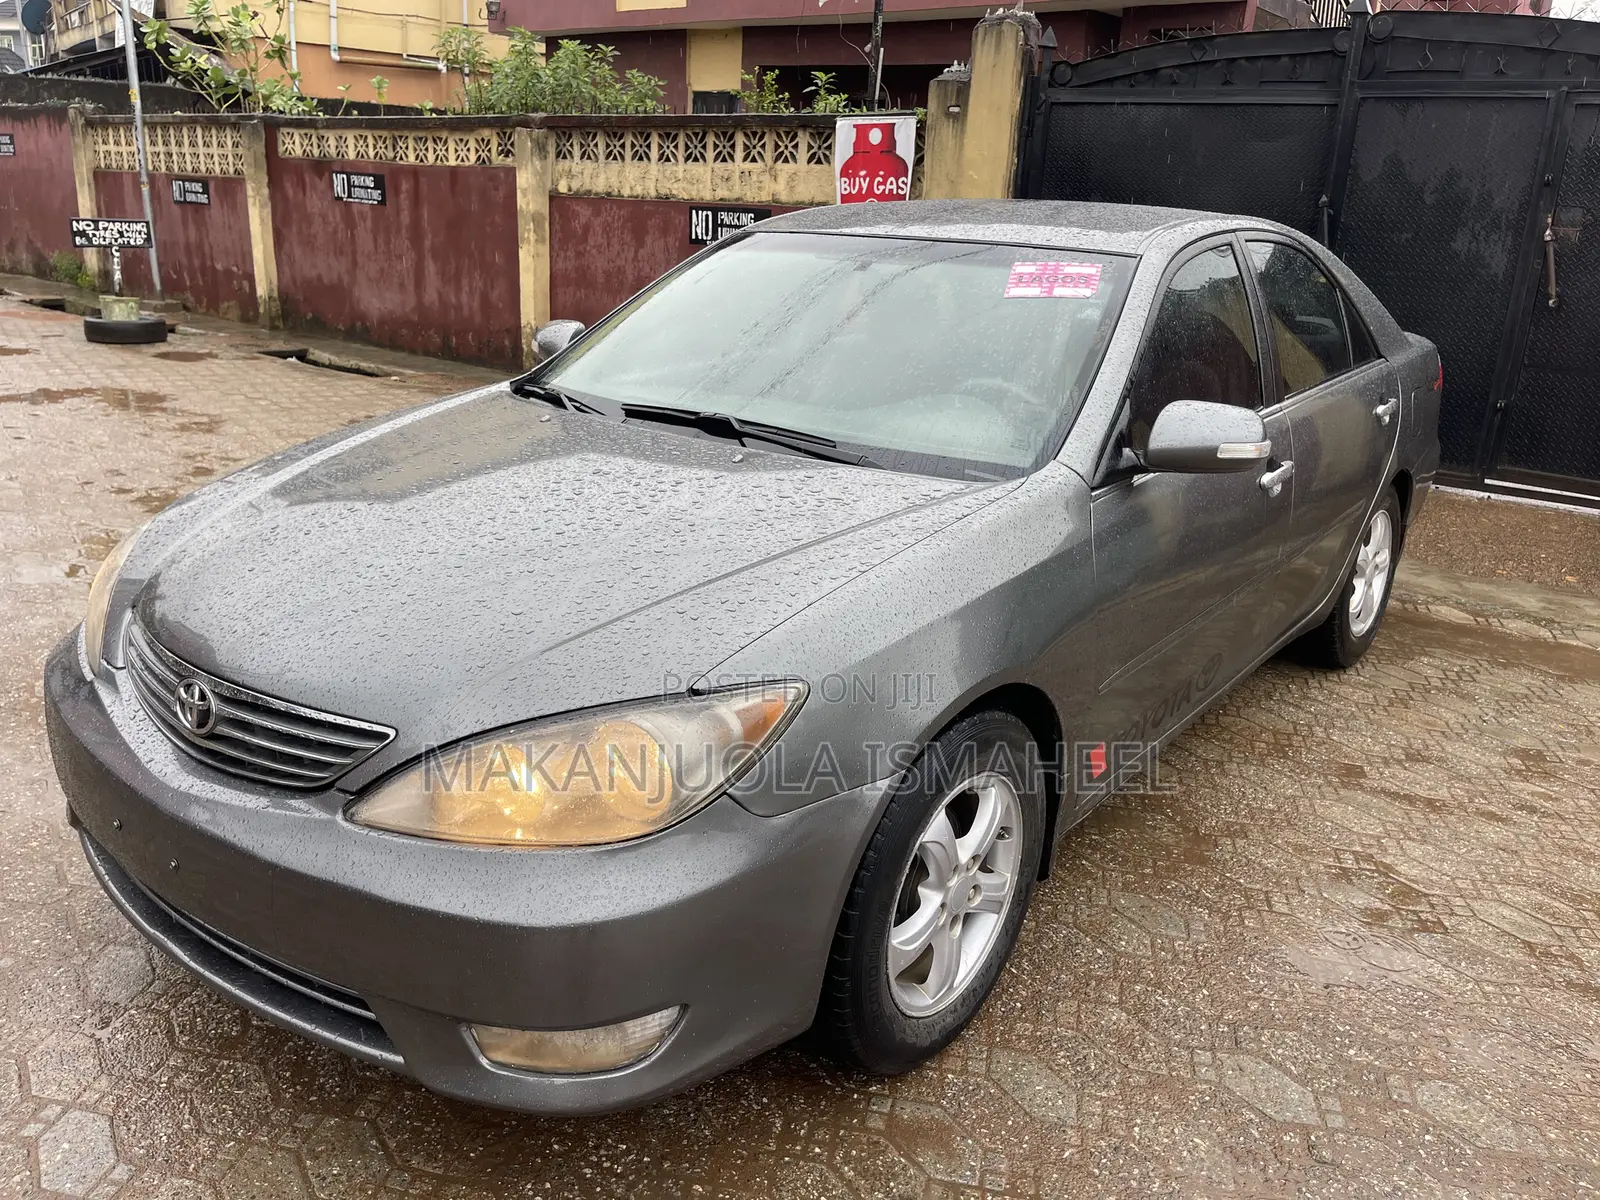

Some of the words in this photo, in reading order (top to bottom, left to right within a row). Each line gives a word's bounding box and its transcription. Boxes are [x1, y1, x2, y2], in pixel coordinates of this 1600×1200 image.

[333, 173, 347, 197] NO
[350, 175, 374, 187] PARKING
[840, 177, 870, 195] BUY
[873, 176, 908, 195] GAS
[691, 209, 713, 241] NO
[717, 211, 755, 226] PARKING
[72, 220, 94, 232] NO
[98, 221, 147, 233] PARKING
[86, 230, 120, 239] TYRES
[123, 229, 148, 239] WILL
[92, 236, 144, 246] DEFLATED
[1018, 275, 1090, 284] LAGOS
